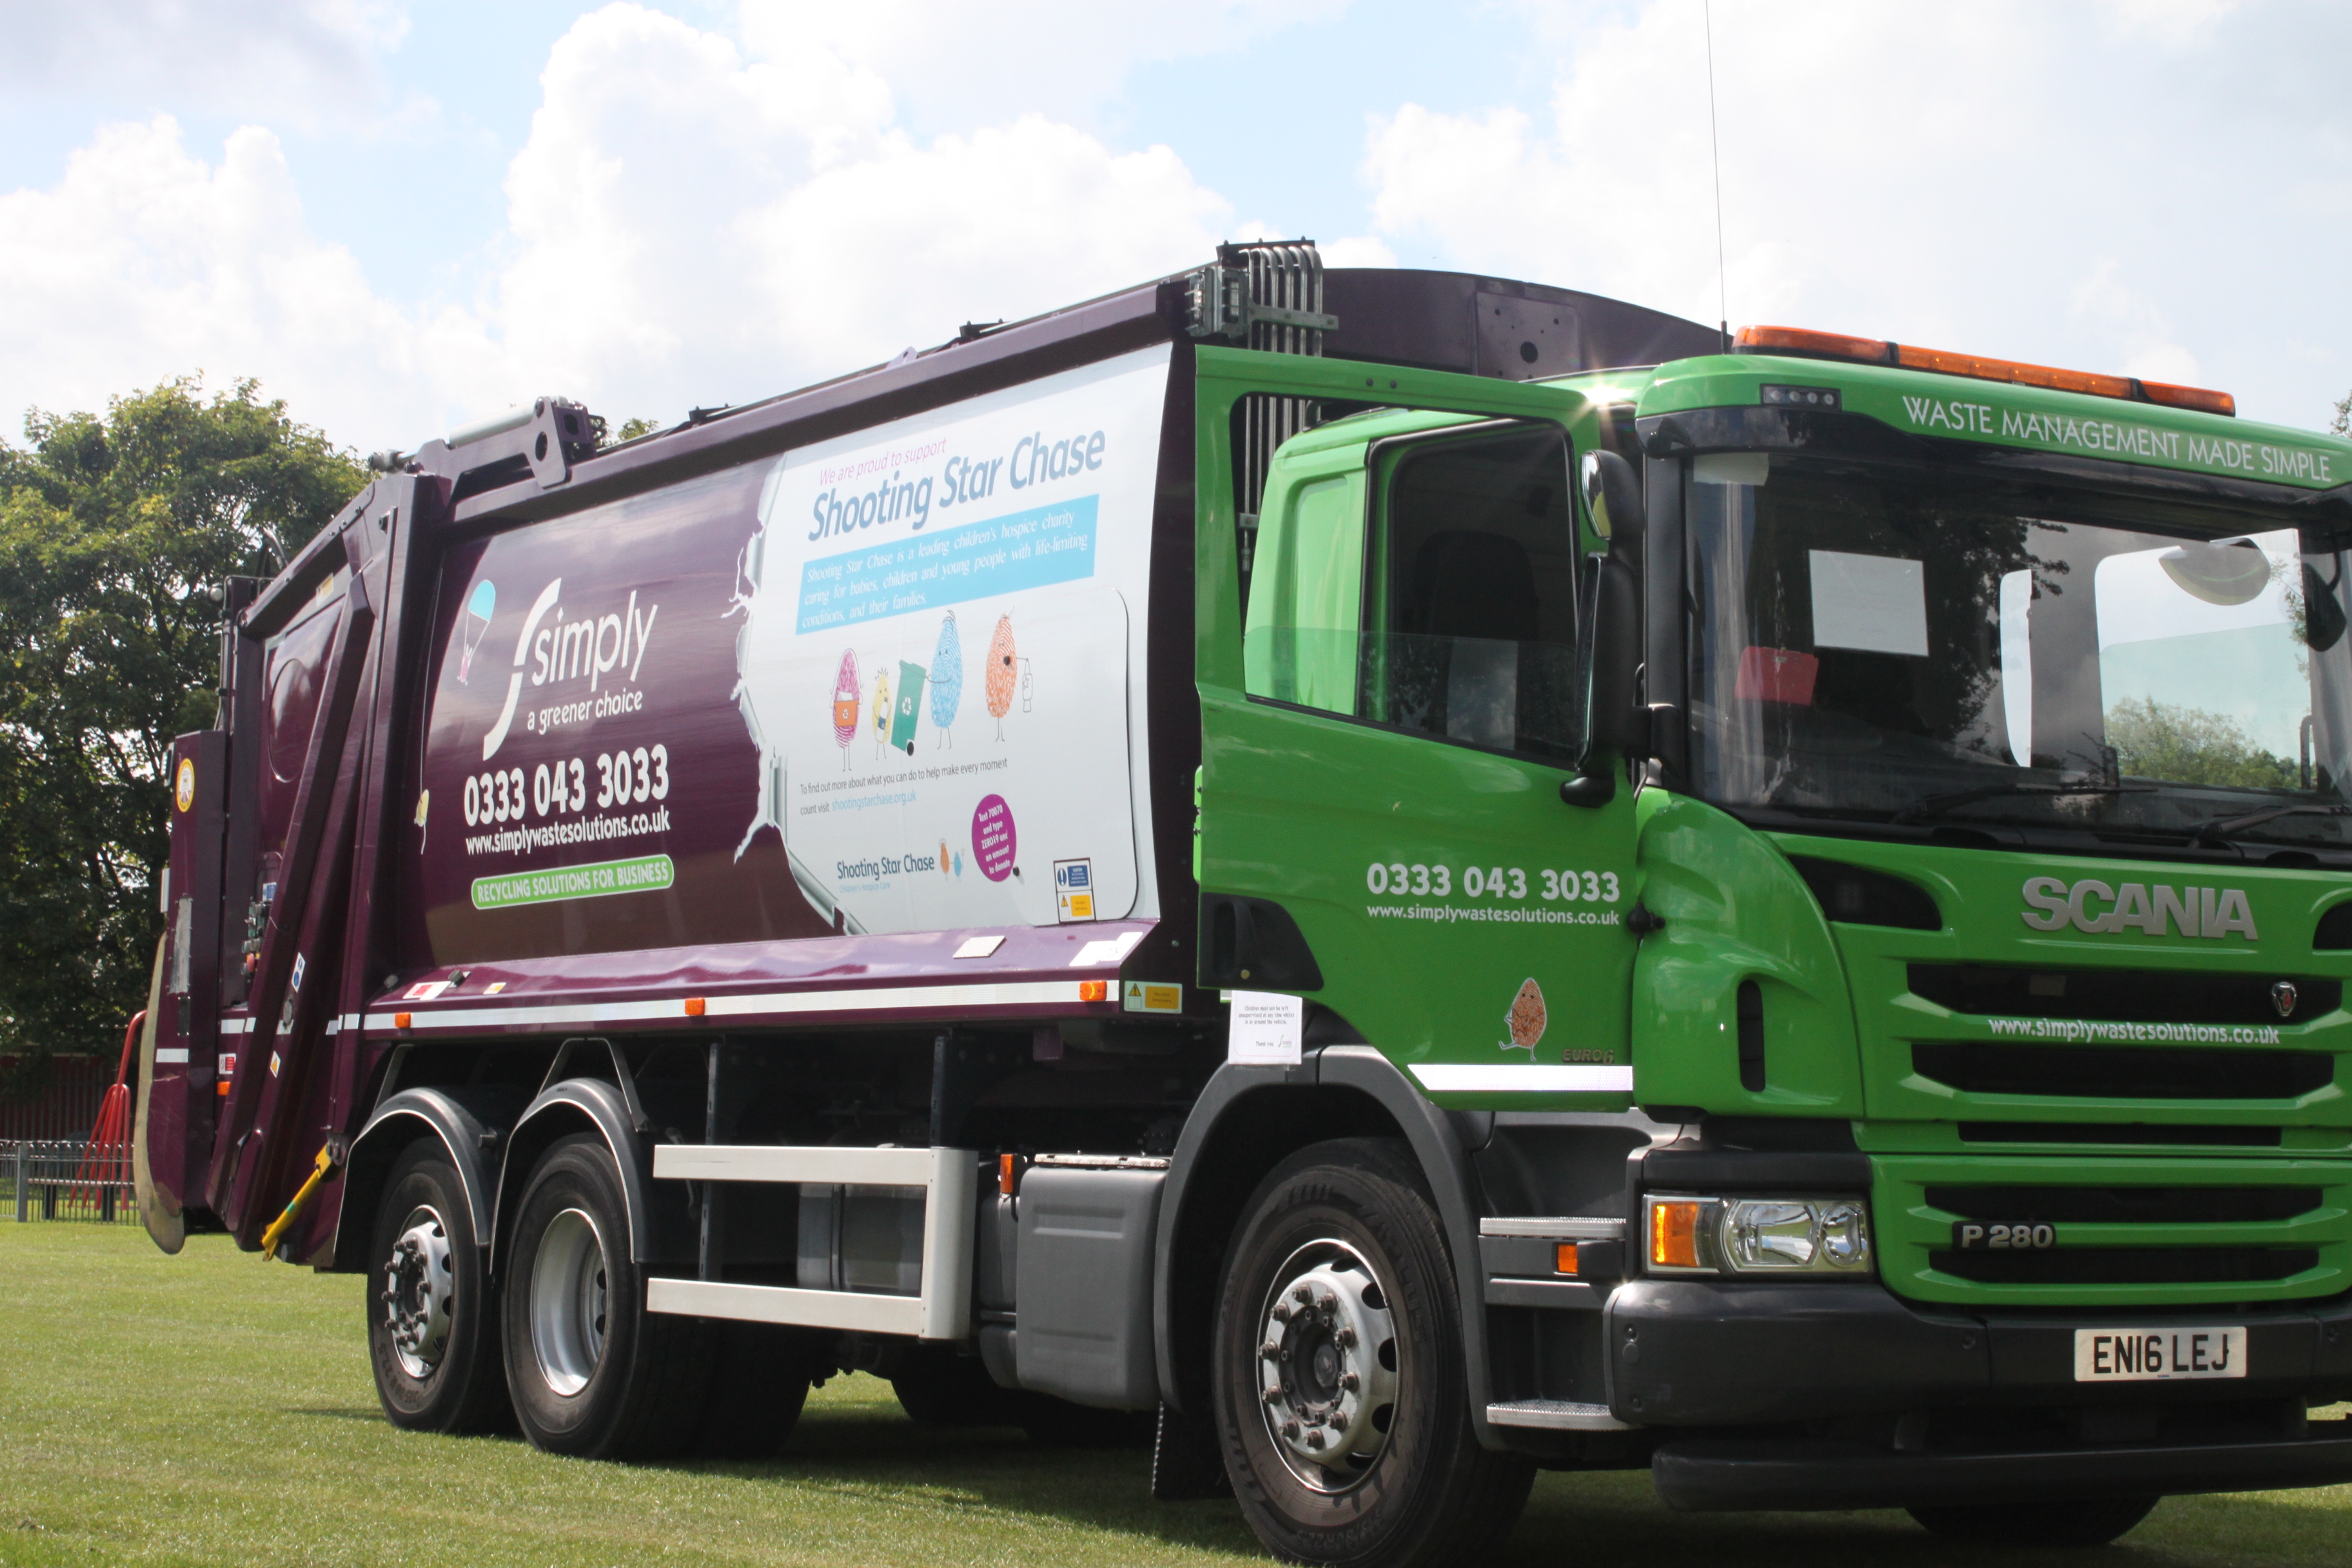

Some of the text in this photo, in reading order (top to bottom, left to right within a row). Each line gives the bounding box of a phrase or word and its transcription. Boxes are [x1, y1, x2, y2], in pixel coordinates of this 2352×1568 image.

[1902, 395, 2332, 483] WASTE MANAGEMENT MADE SIMPLE
[819, 438, 947, 486] We are proud to support
[808, 430, 1105, 542] Shooting Star Chase
[807, 563, 843, 583] Shooting
[847, 559, 863, 574] Star
[867, 553, 893, 569] Chase
[897, 547, 904, 562] is
[908, 549, 914, 559] a
[919, 538, 950, 557] leading
[1001, 519, 1037, 539] hospice
[1042, 510, 1075, 529] charity
[804, 532, 1088, 606] caring for babies, children and young people with life-limiting
[802, 590, 927, 628] conditions, and their families.
[532, 589, 658, 693] simply
[527, 687, 643, 735] a greener choice
[464, 743, 670, 827] 0333 043 3033
[800, 784, 807, 795] To
[808, 782, 819, 794] find
[820, 781, 830, 792] out
[832, 779, 847, 791] more
[848, 777, 866, 789] about
[866, 773, 882, 785] what
[883, 774, 895, 787] you
[896, 772, 907, 782] can
[908, 768, 917, 781] do
[918, 769, 925, 780] to
[926, 766, 941, 780] help
[941, 764, 960, 777] make
[960, 763, 979, 775] every
[800, 789, 917, 815] count visit shootingstarchase.org.uk
[978, 804, 1004, 822] Text 70070
[466, 804, 671, 855] www.simplywastesolutions.co.uk
[983, 821, 1004, 835] and type
[837, 853, 935, 881] Shooting Star Chase
[985, 845, 1009, 862] an amount
[989, 860, 1011, 875] to donate
[477, 861, 669, 903] RECYCLING SOLUTIONS FOR BUSINESS
[1367, 862, 1620, 903] 0333 043 3033
[1367, 903, 1620, 926] www.simplywastesolutions.co.uk
[2021, 877, 2259, 941] SCANIA
[1988, 1017, 2280, 1044] www.simplywastesolutions.co.uk
[1961, 1224, 2054, 1249] P 280
[2093, 1334, 2230, 1374] EN16 LEJ
